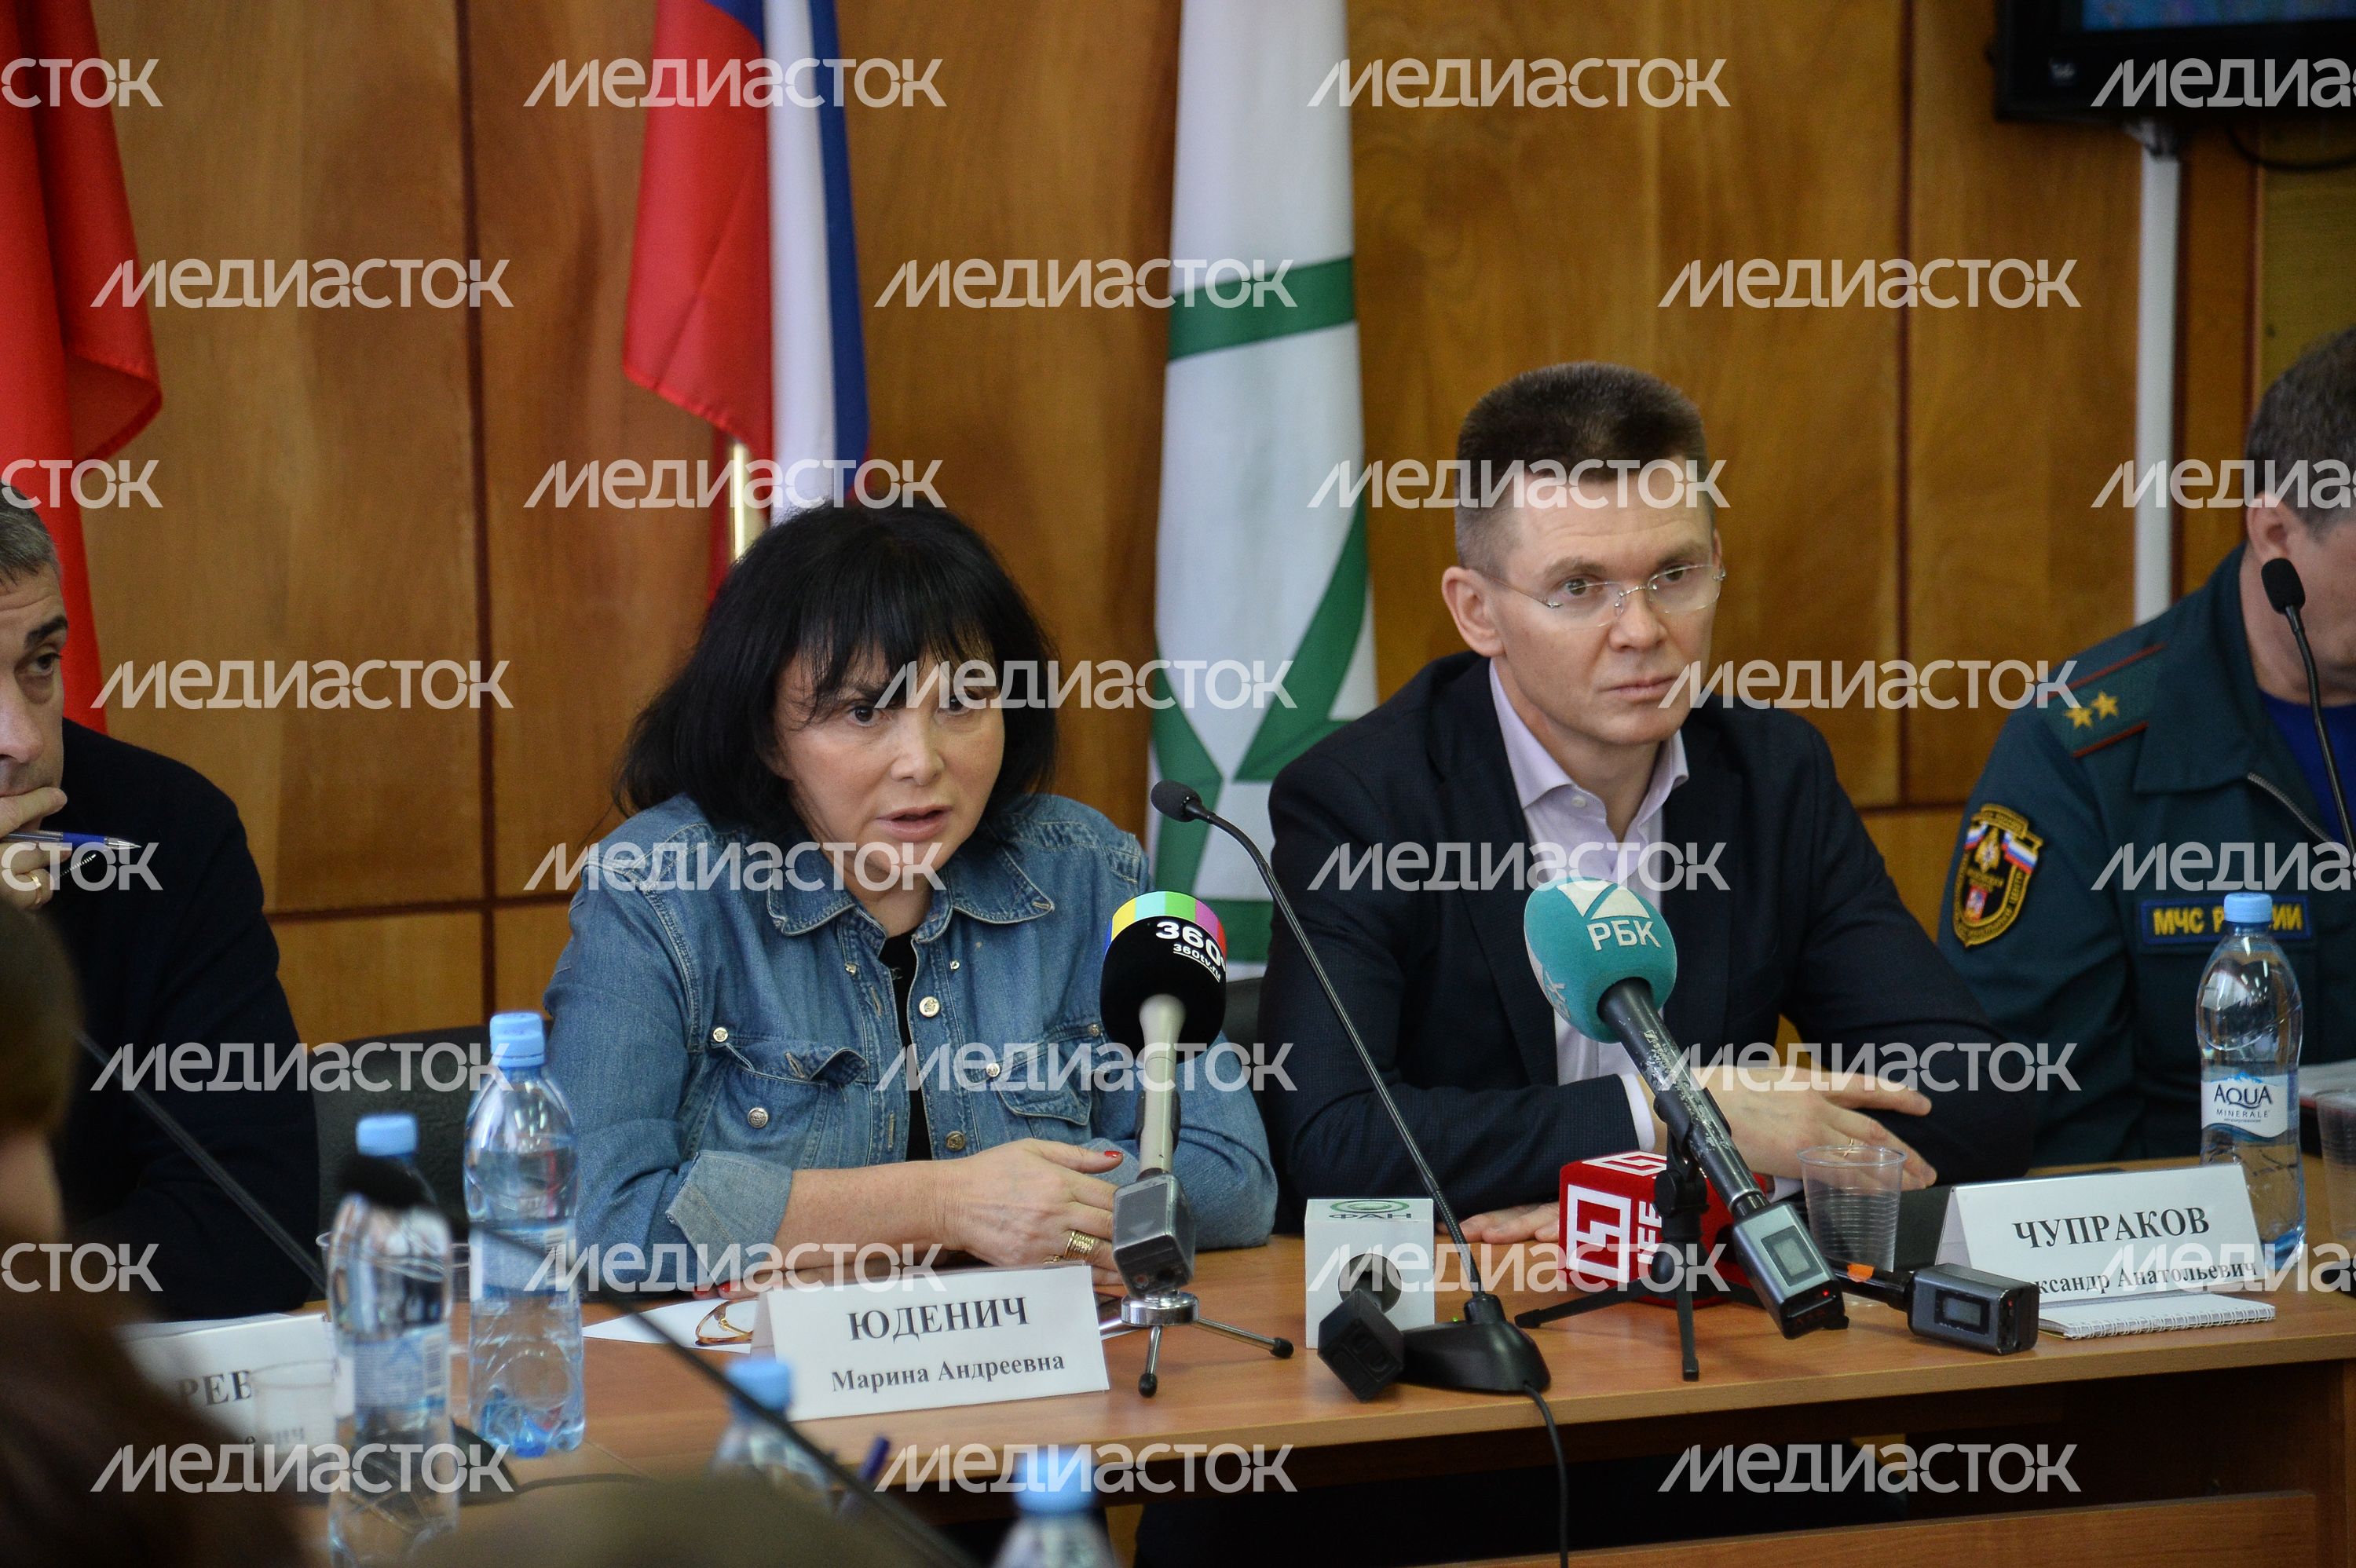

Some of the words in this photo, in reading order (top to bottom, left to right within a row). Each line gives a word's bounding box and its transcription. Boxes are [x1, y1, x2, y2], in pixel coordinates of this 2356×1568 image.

[1586, 919, 1662, 952] РБК
[2153, 907, 2204, 935] МЧС
[2212, 904, 2303, 933] РИИ
[1156, 921, 1226, 972] 360
[1173, 944, 1221, 981] 360tv.ru
[2214, 1084, 2273, 1109] AQUA
[2216, 1109, 2269, 1118] MINERALE
[1637, 1201, 1663, 1267] IFE
[2012, 1207, 2210, 1248] ЧУПРАКОВ
[2036, 1272, 2110, 1294] ксандр
[2117, 1262, 2257, 1288] Анатольевич
[847, 1296, 1030, 1345] ЮДЕНИЧ
[177, 1369, 251, 1406] РЕВ
[831, 1365, 930, 1394] Марина
[938, 1354, 1065, 1383] Андреевна
